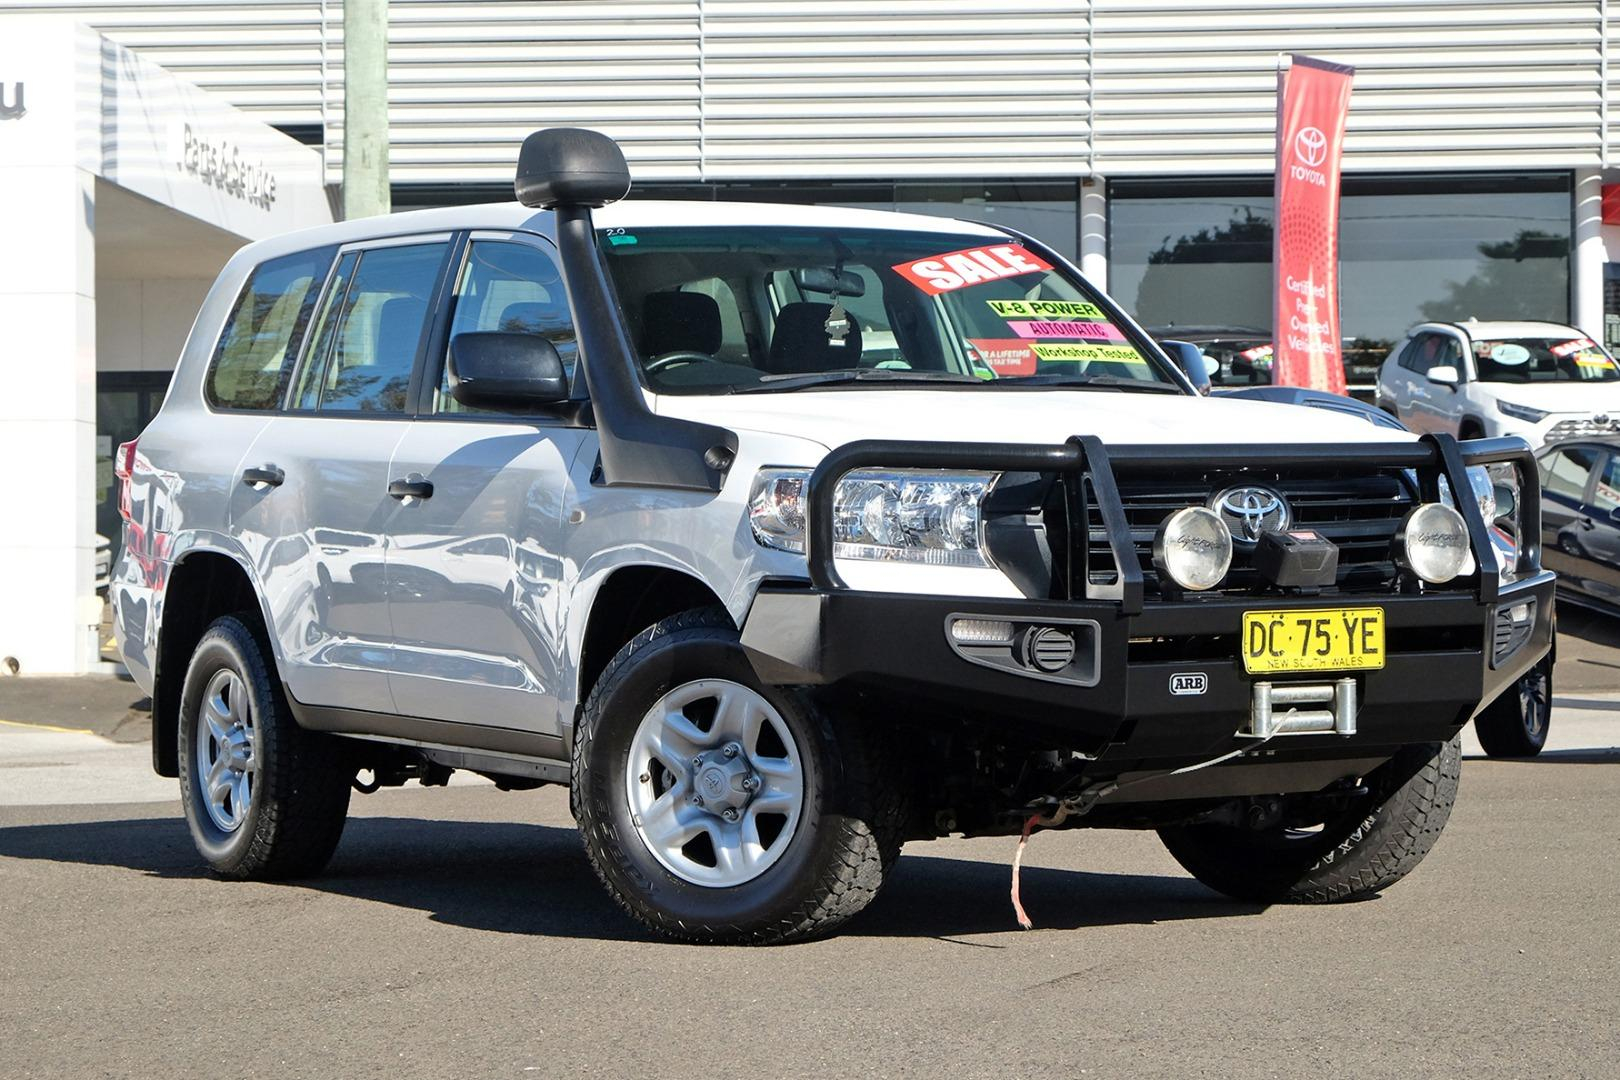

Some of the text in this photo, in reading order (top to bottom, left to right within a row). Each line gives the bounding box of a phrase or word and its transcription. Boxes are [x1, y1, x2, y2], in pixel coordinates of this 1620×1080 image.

[184, 122, 217, 175] Parts
[232, 146, 276, 203] Service
[1291, 164, 1327, 187] TOYOTA
[911, 246, 1042, 290] SALE
[991, 302, 1098, 316] V-8 POWER
[1029, 322, 1108, 337] AUTOMATIC
[997, 349, 1031, 358] LIFETIME
[1034, 346, 1141, 361] Workshop Tested
[1267, 659, 1290, 670] NEW
[1332, 656, 1364, 668] WALES
[1174, 677, 1203, 690] ARB
